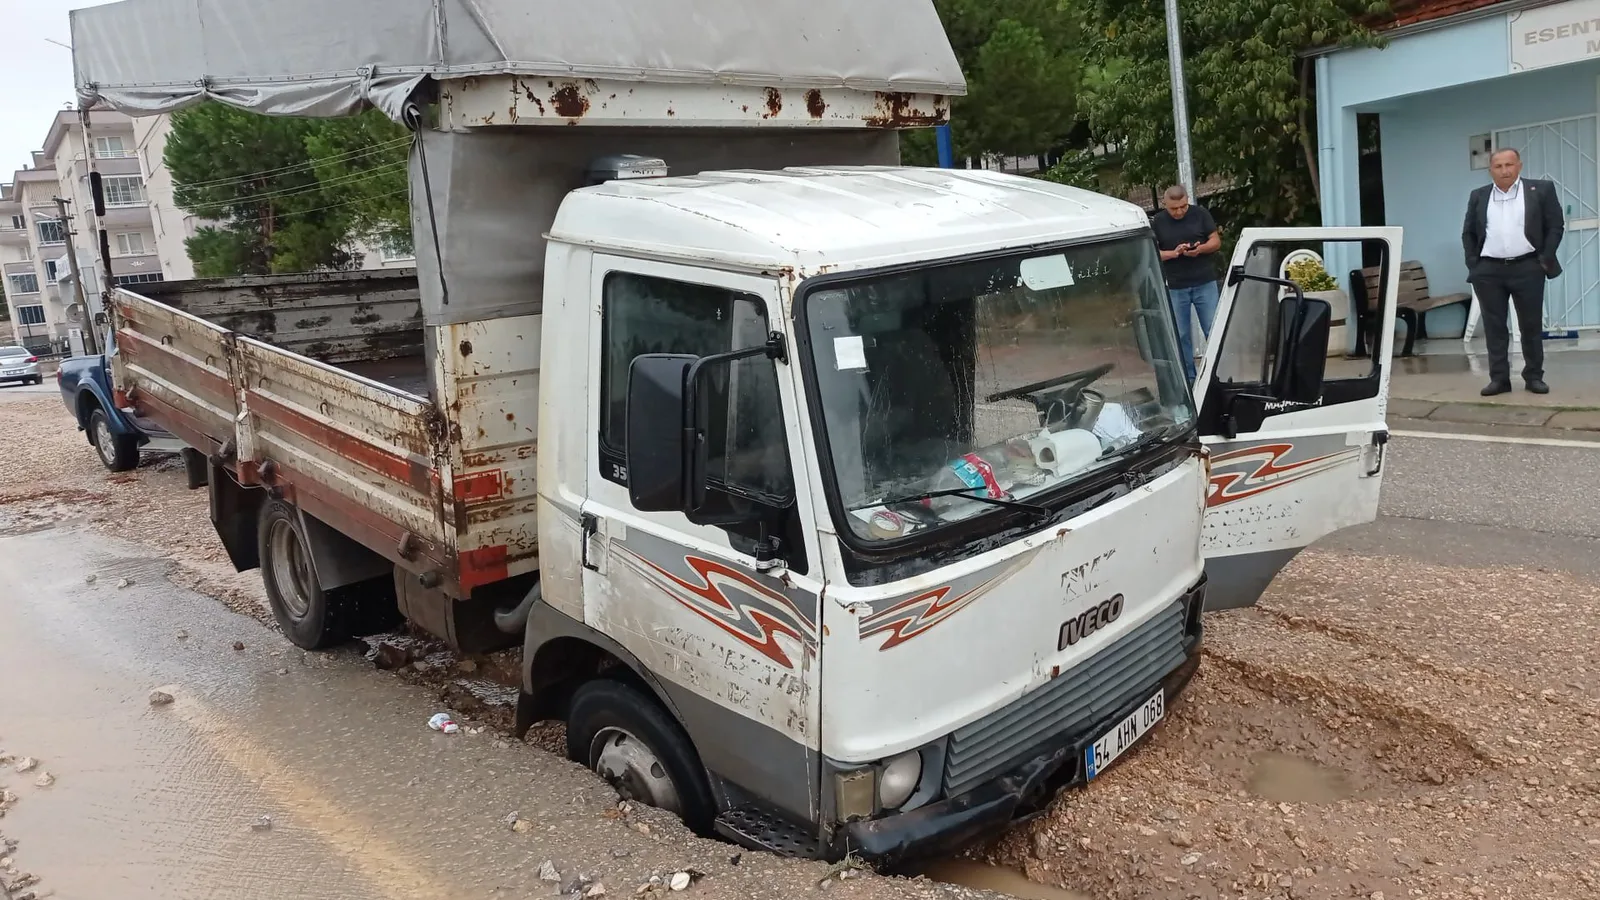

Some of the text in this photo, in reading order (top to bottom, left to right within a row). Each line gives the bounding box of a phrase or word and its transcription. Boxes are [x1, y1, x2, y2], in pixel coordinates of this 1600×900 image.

[1057, 593, 1125, 652] IVECO
[1095, 694, 1162, 769] 54 AHN 068
